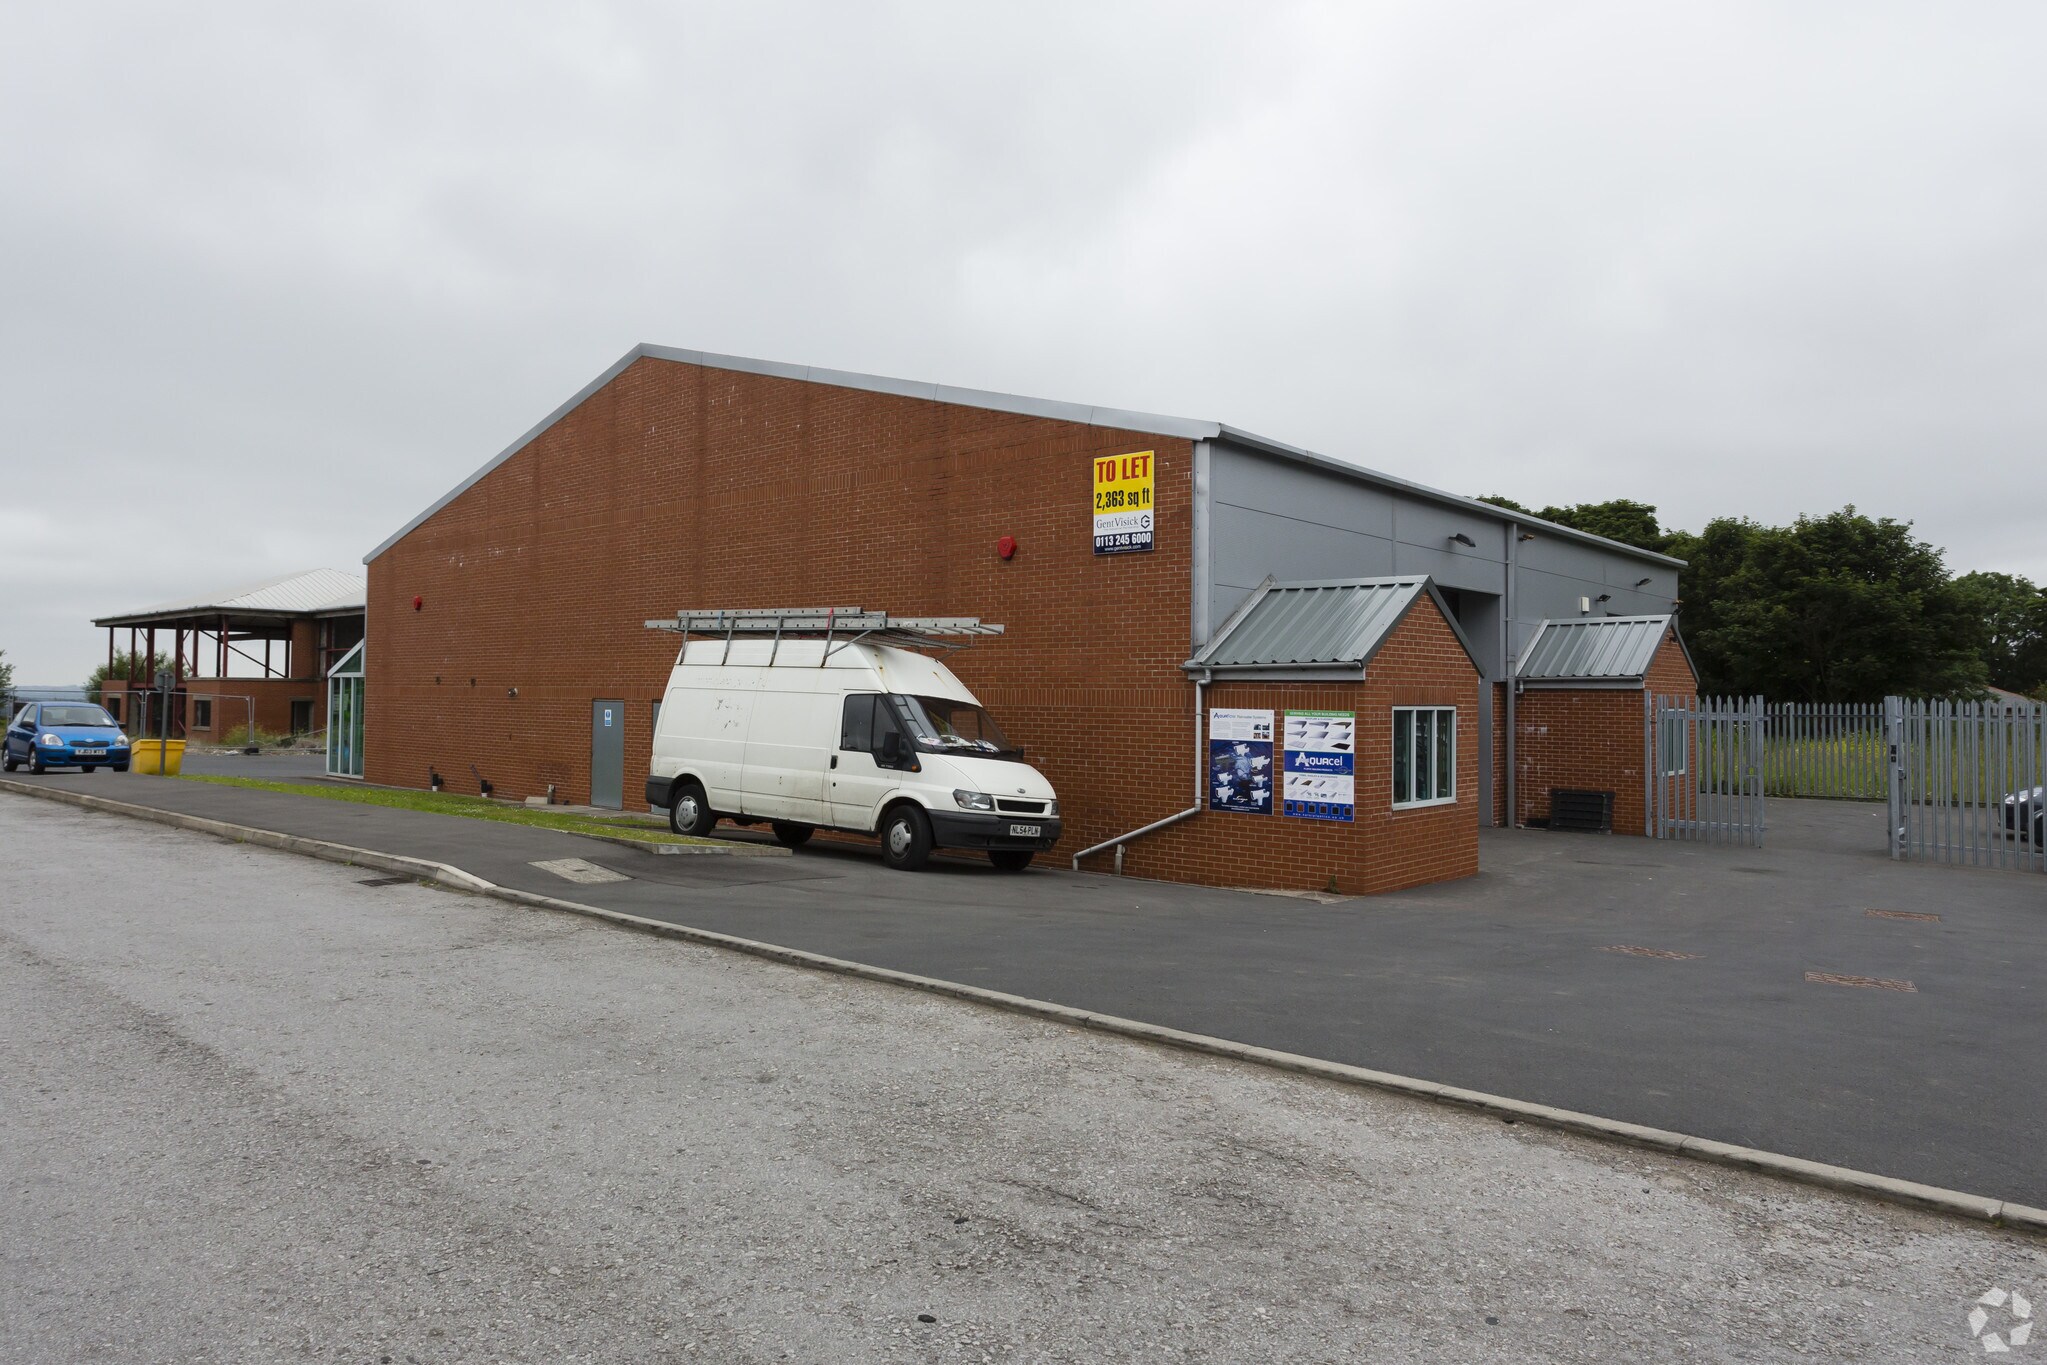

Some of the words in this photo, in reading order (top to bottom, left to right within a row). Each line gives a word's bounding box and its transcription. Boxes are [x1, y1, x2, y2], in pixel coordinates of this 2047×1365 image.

[1096, 460, 1116, 483] TO
[1122, 455, 1150, 480] LET
[1096, 490, 1124, 511] 2,363
[1128, 492, 1139, 507] sq
[1142, 488, 1150, 504] ft
[1096, 536, 1114, 547] 0113
[1116, 534, 1130, 546] 245
[1132, 532, 1152, 544] 6000
